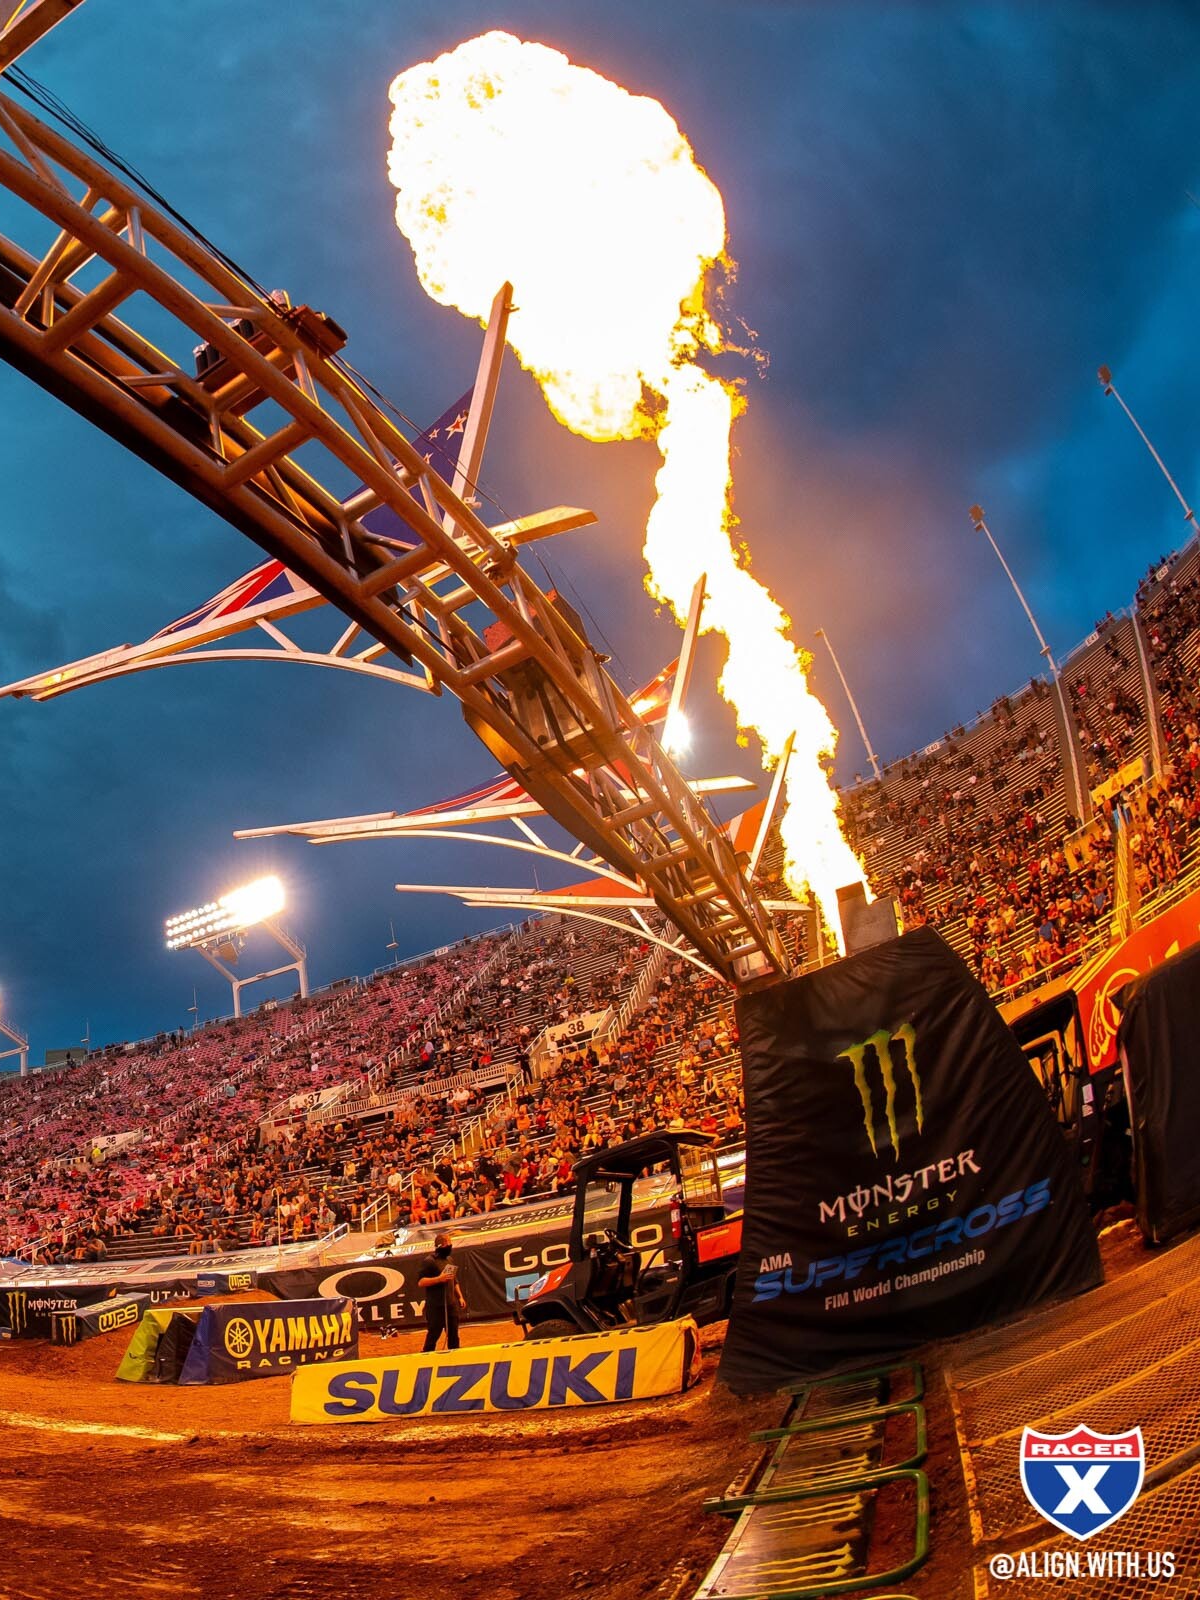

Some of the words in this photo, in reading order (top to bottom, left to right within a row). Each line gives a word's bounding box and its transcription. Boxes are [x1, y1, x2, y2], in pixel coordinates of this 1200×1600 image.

[568, 1020, 585, 1034] 38
[307, 1091, 321, 1105] 37
[105, 1136, 116, 1145] 36
[818, 1149, 981, 1224] MONSTER
[485, 1213, 523, 1226] UTAH
[847, 1190, 958, 1237] ENERGY
[752, 1177, 1051, 1303] SUPERCROSS
[759, 1252, 793, 1274] AMA
[824, 1291, 850, 1312] FIM
[853, 1279, 892, 1305] World
[894, 1247, 986, 1291] Championship
[28, 1298, 77, 1311] MONSTER
[99, 1303, 139, 1333] WPS
[254, 1311, 352, 1354] YAMAHA
[237, 1348, 345, 1370] RACING
[323, 1347, 638, 1416] SUZUKI
